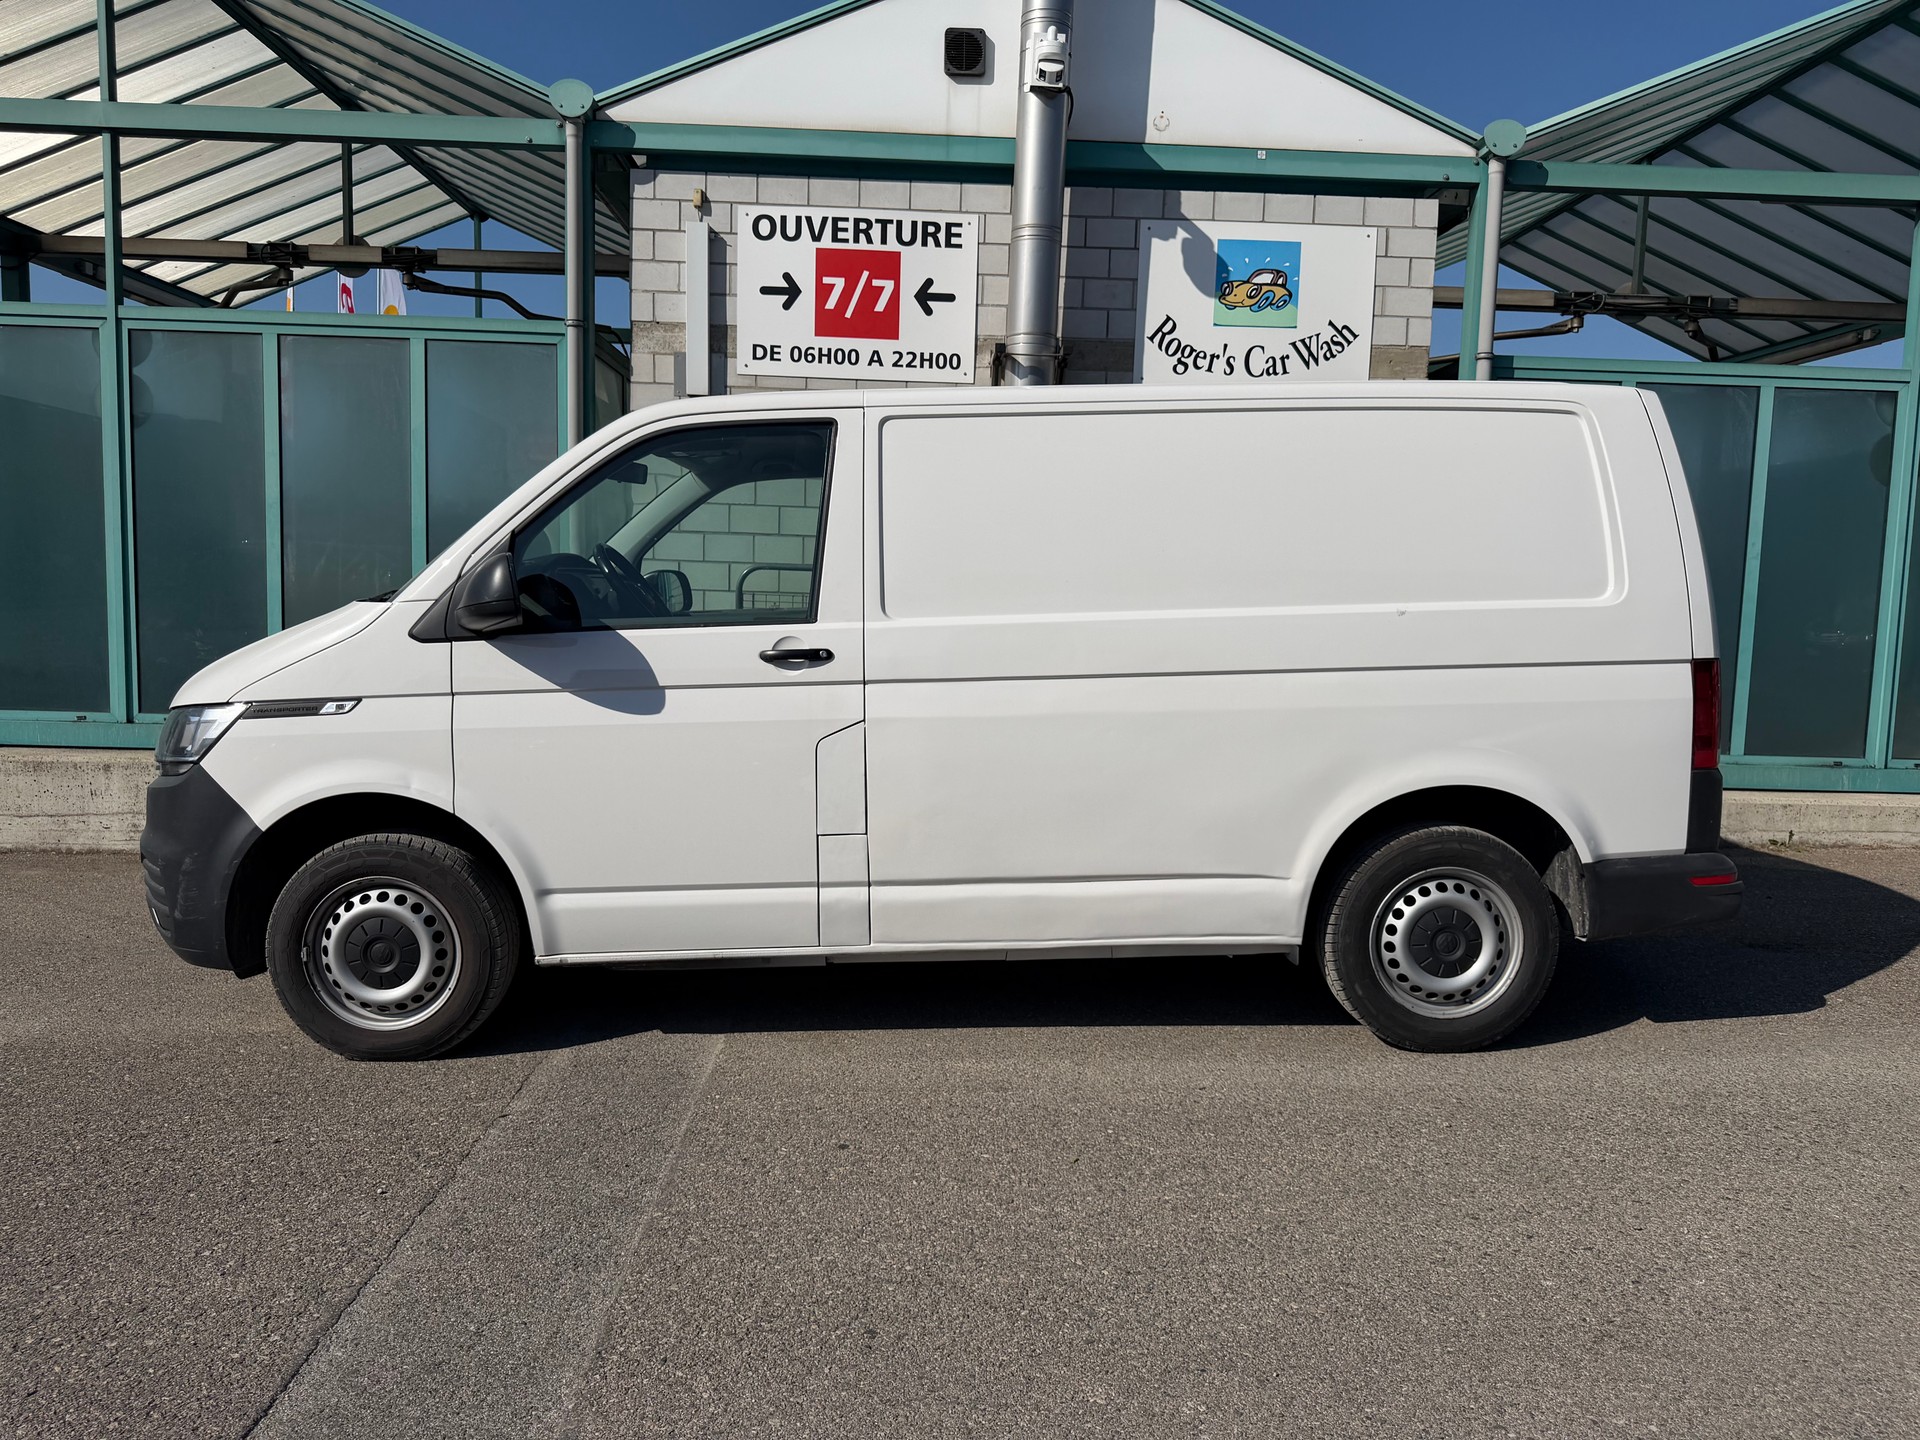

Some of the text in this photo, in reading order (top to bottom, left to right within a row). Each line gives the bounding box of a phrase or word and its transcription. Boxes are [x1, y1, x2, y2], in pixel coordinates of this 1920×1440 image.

[752, 214, 963, 249] OUVERTURE
[822, 270, 895, 319] 7/7
[752, 343, 962, 370] DE 06H00 A 22H00
[1146, 314, 1360, 378] Roger's Car Wash
[252, 705, 319, 714] TRANSPORTER
